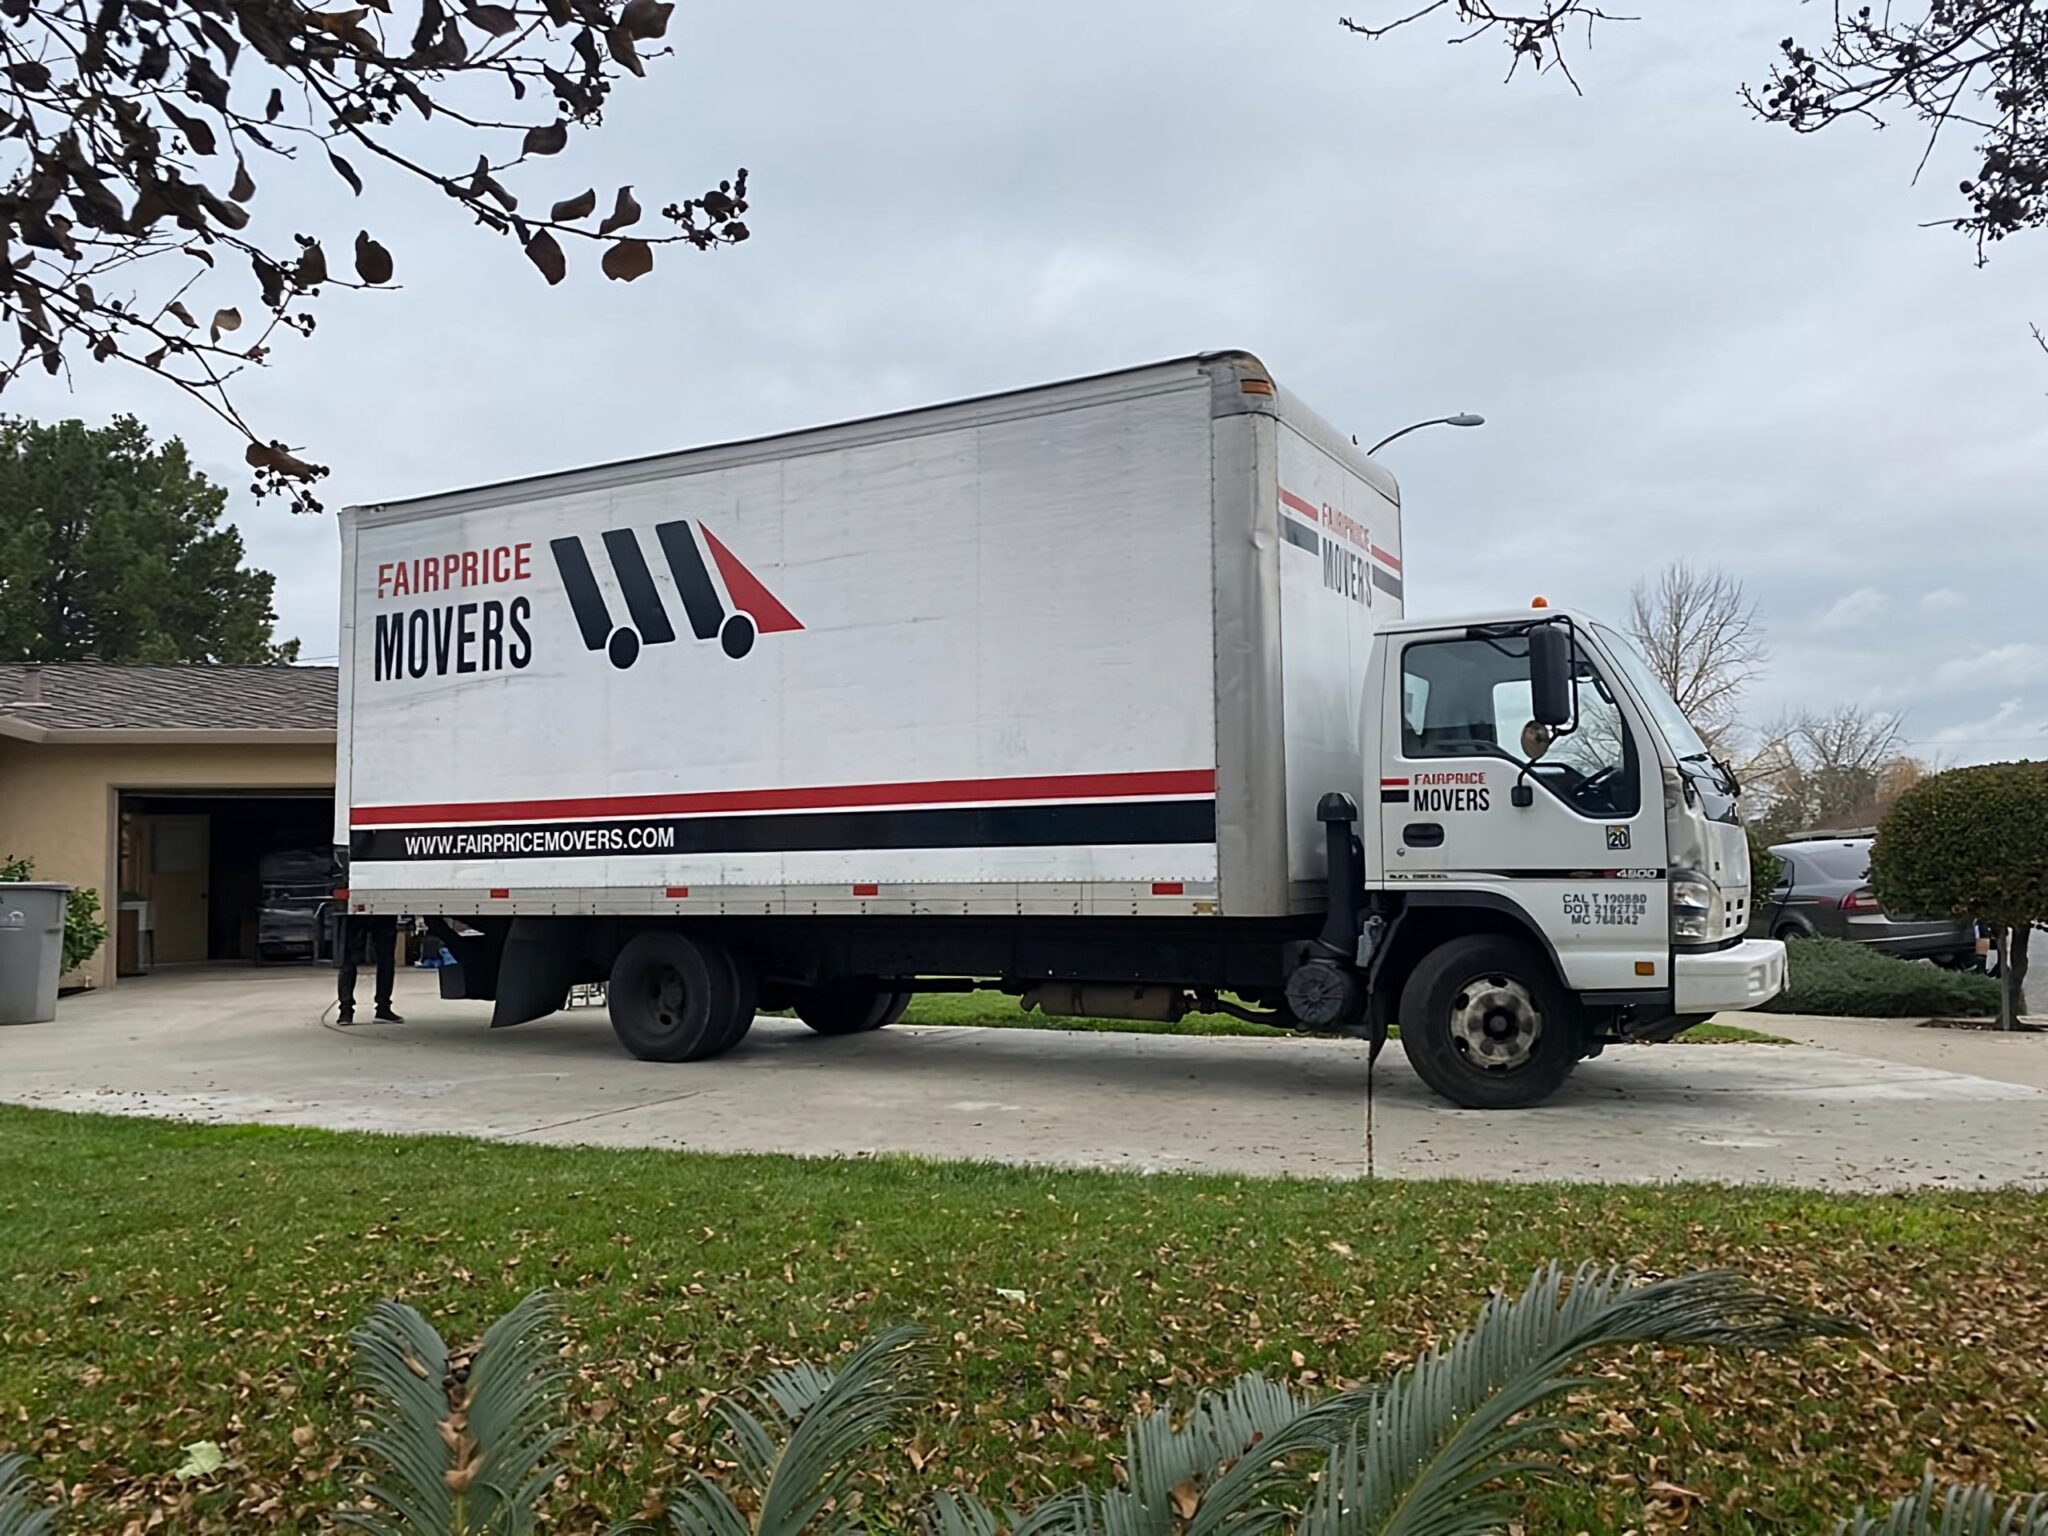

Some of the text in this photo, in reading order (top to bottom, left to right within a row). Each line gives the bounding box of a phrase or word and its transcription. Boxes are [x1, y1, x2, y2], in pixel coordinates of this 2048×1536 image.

[1322, 502, 1370, 552] FARPCE
[378, 542, 532, 598] FAIRPRICE
[1322, 536, 1372, 608] MOVERS
[374, 596, 532, 682] MOVERS
[1414, 772, 1487, 785] FAIRPRICE
[1414, 788, 1490, 811] MOVERS
[404, 827, 675, 856] WWW.FAIRPRICEMOVERS.COM
[1609, 831, 1628, 847] 20
[1562, 893, 1589, 904] CAL
[1592, 893, 1599, 904] T
[1564, 904, 1590, 914] DOT
[1571, 914, 1591, 925] MC
